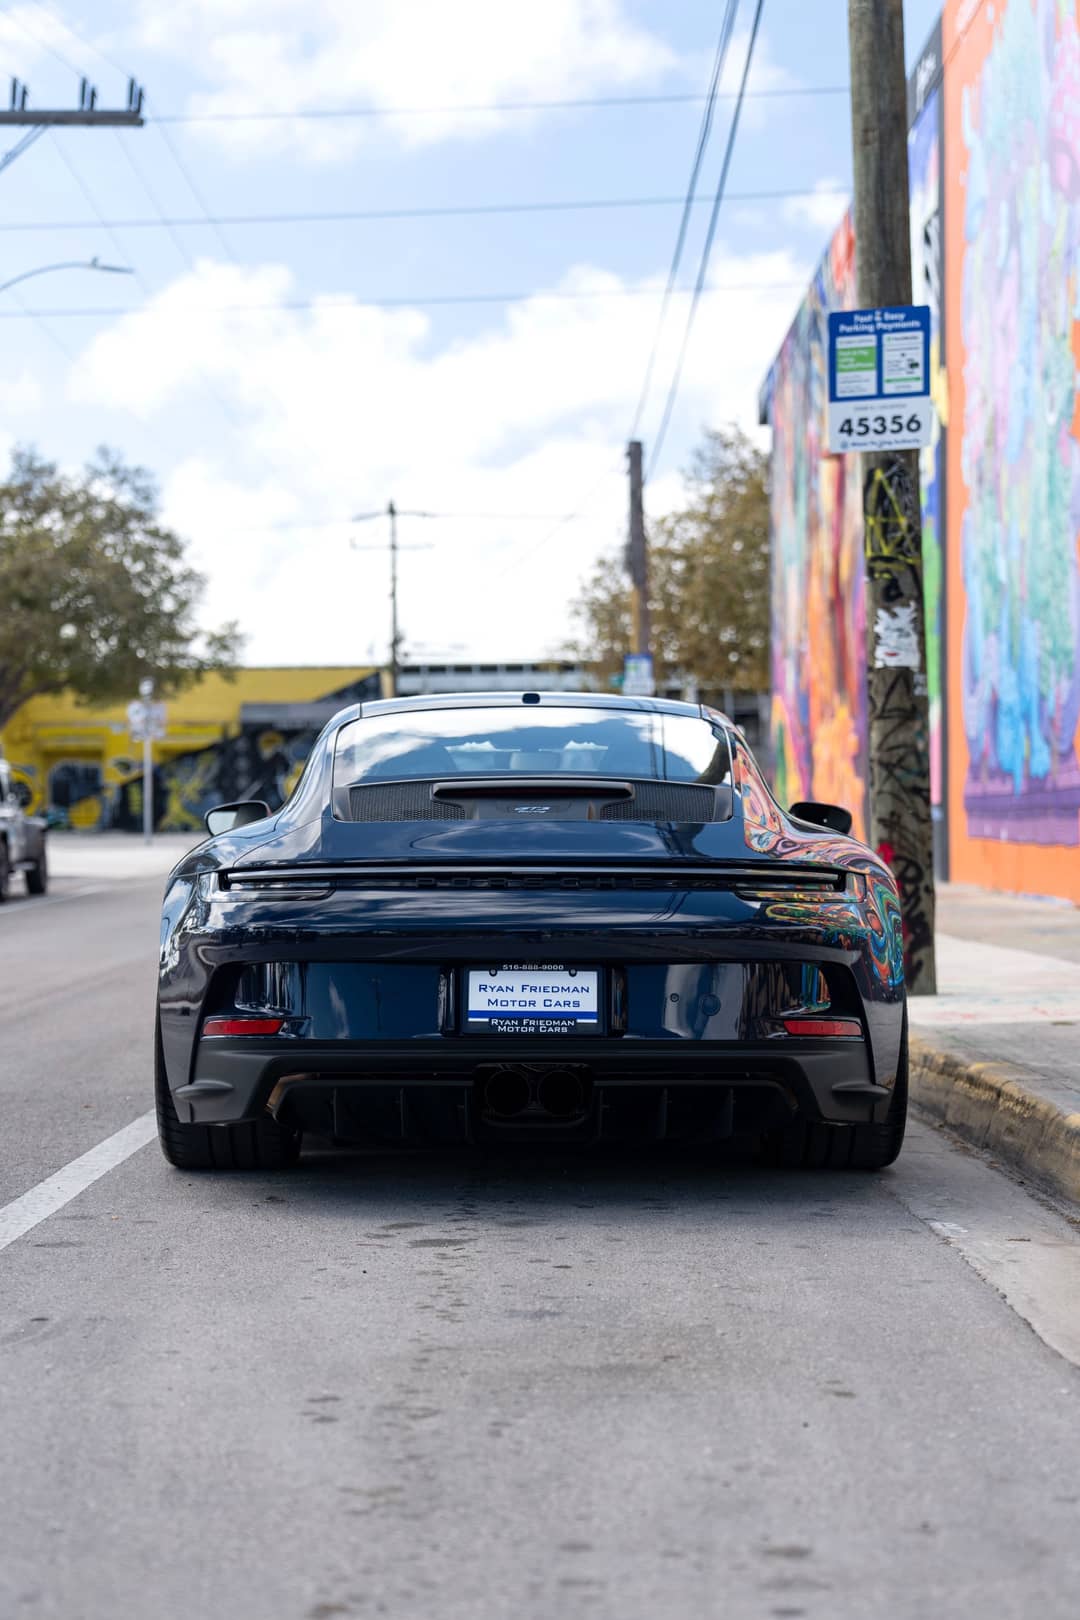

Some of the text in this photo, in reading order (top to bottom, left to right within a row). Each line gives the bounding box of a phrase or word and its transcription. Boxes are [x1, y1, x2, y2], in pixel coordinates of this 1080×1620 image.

[838, 319, 921, 334] Parking Payments
[838, 413, 922, 437] 45356
[415, 876, 655, 889] PORSCHE
[478, 984, 590, 994] RYAN FRIEDMAN
[487, 998, 581, 1008] MOTOR CARS
[490, 1018, 575, 1027] RYAN FRIEDMAN
[497, 1025, 568, 1033] MOTOR CARS
